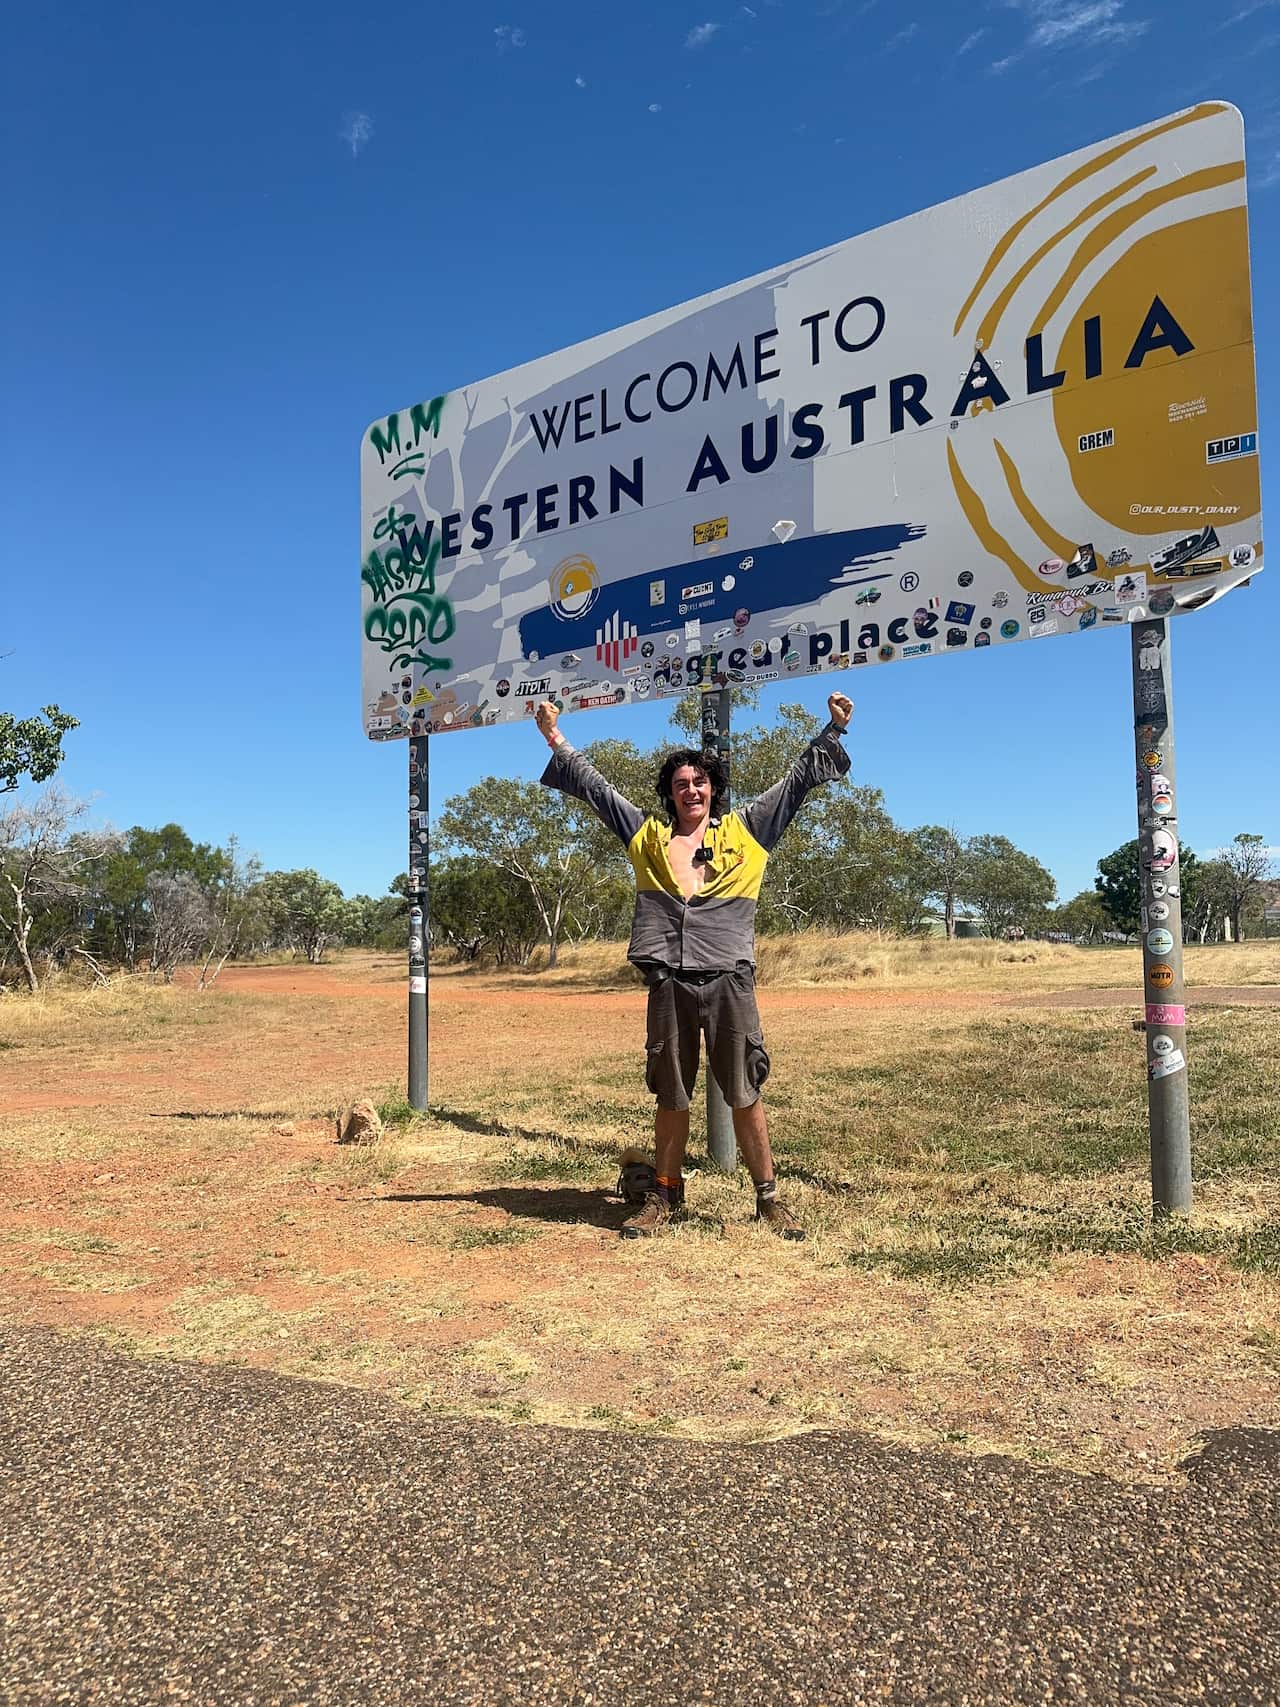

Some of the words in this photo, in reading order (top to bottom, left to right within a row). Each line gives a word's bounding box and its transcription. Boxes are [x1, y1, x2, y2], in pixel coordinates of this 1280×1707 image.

[530, 328, 781, 454] WELCOME
[800, 296, 885, 366] TO
[399, 456, 643, 565] WESTERN
[686, 295, 1195, 492] AUSTRALIA
[1079, 429, 1114, 451] GREM
[1209, 435, 1253, 455] TPI
[810, 612, 939, 665] place
